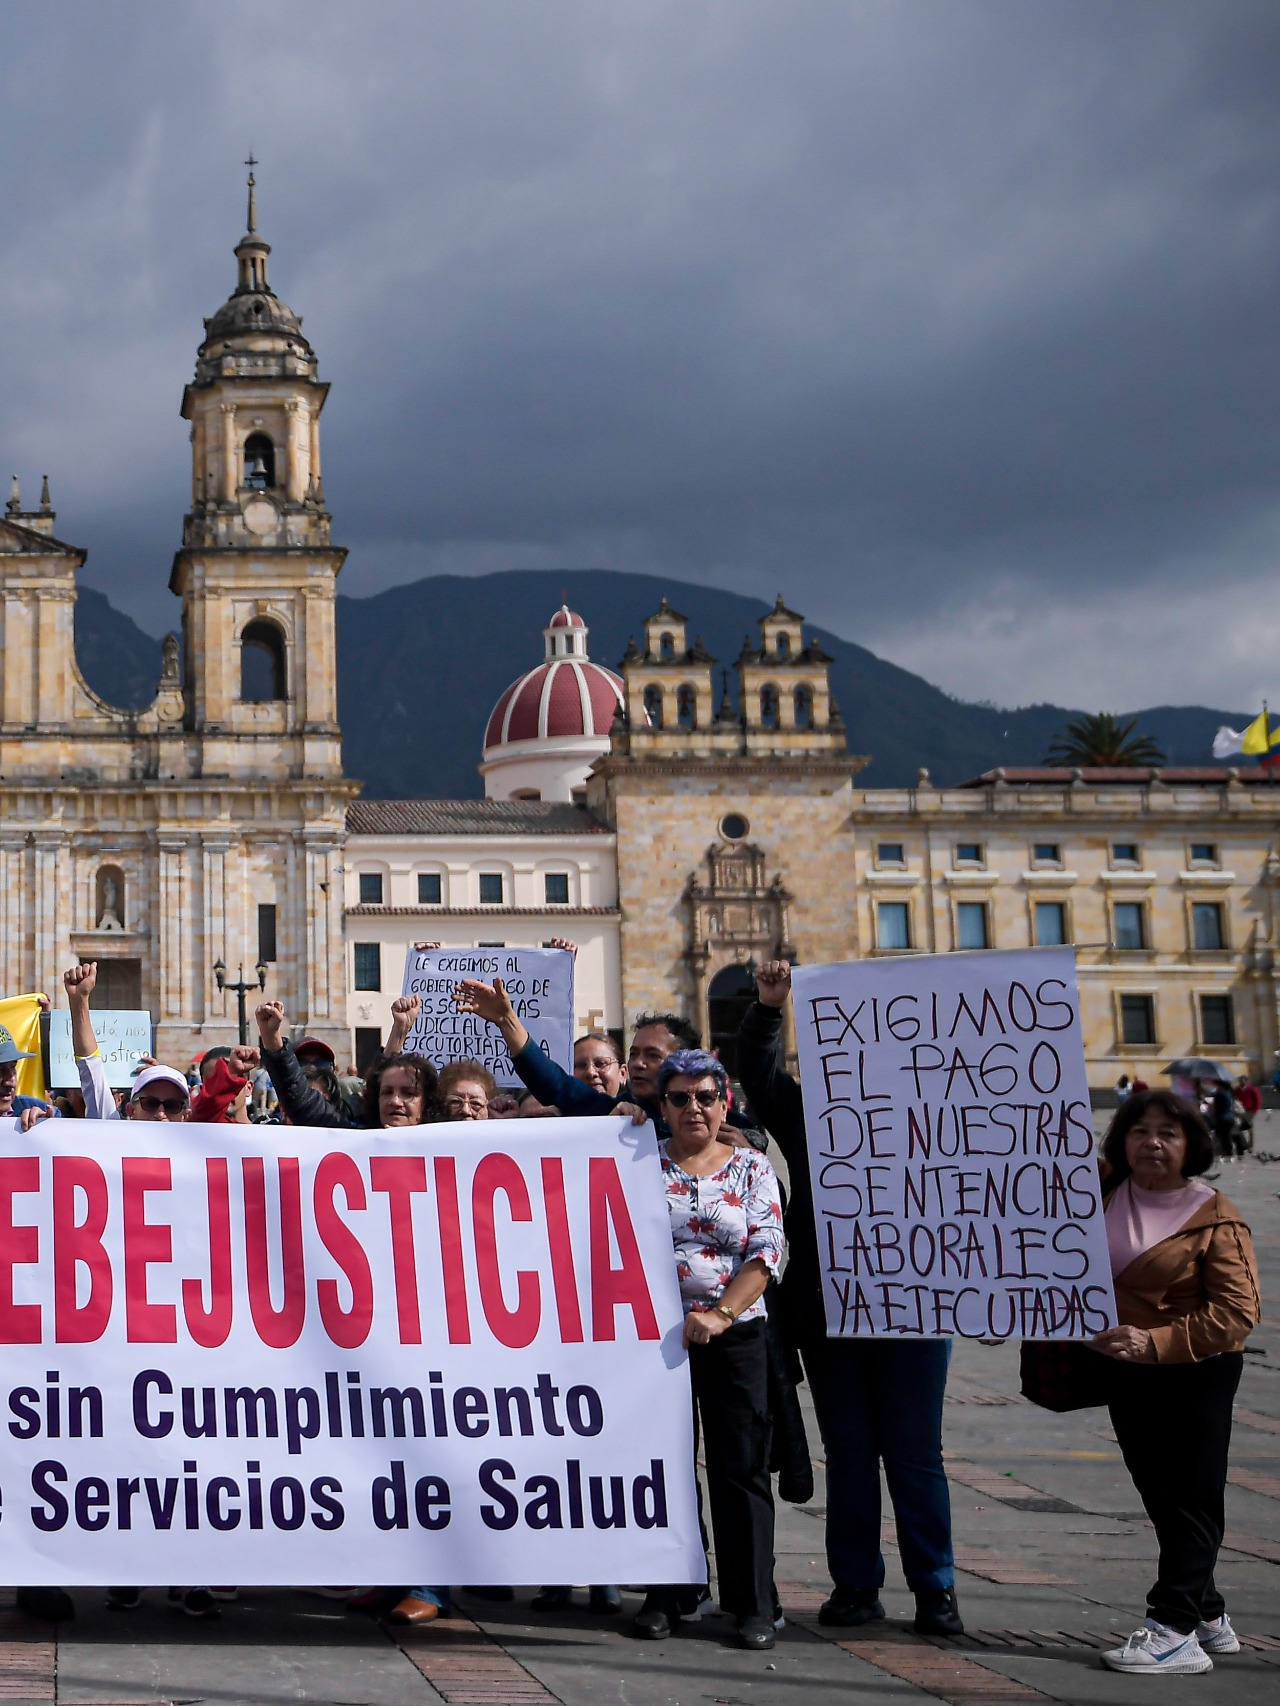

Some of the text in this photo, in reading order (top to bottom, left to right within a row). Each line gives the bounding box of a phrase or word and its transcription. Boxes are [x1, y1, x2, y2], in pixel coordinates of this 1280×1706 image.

[411, 978, 464, 994] GOBIERN
[532, 978, 550, 997] DE
[415, 957, 521, 973] LE EXIGIMOS AL
[809, 979, 1074, 1045] EXIGIMOS
[819, 1040, 1061, 1103] EL PAGO
[819, 1100, 1094, 1160] DE NUESTRAS
[820, 1161, 1097, 1219] SENTENCIAS
[827, 1220, 1089, 1280] LABORALES
[831, 1276, 1110, 1339] YA EJECUTADAS
[7, 1370, 104, 1440] sin
[132, 1369, 605, 1455] Cumplimiento
[30, 1458, 346, 1532] Servicios
[372, 1460, 452, 1532] de
[479, 1458, 669, 1530] Salud
